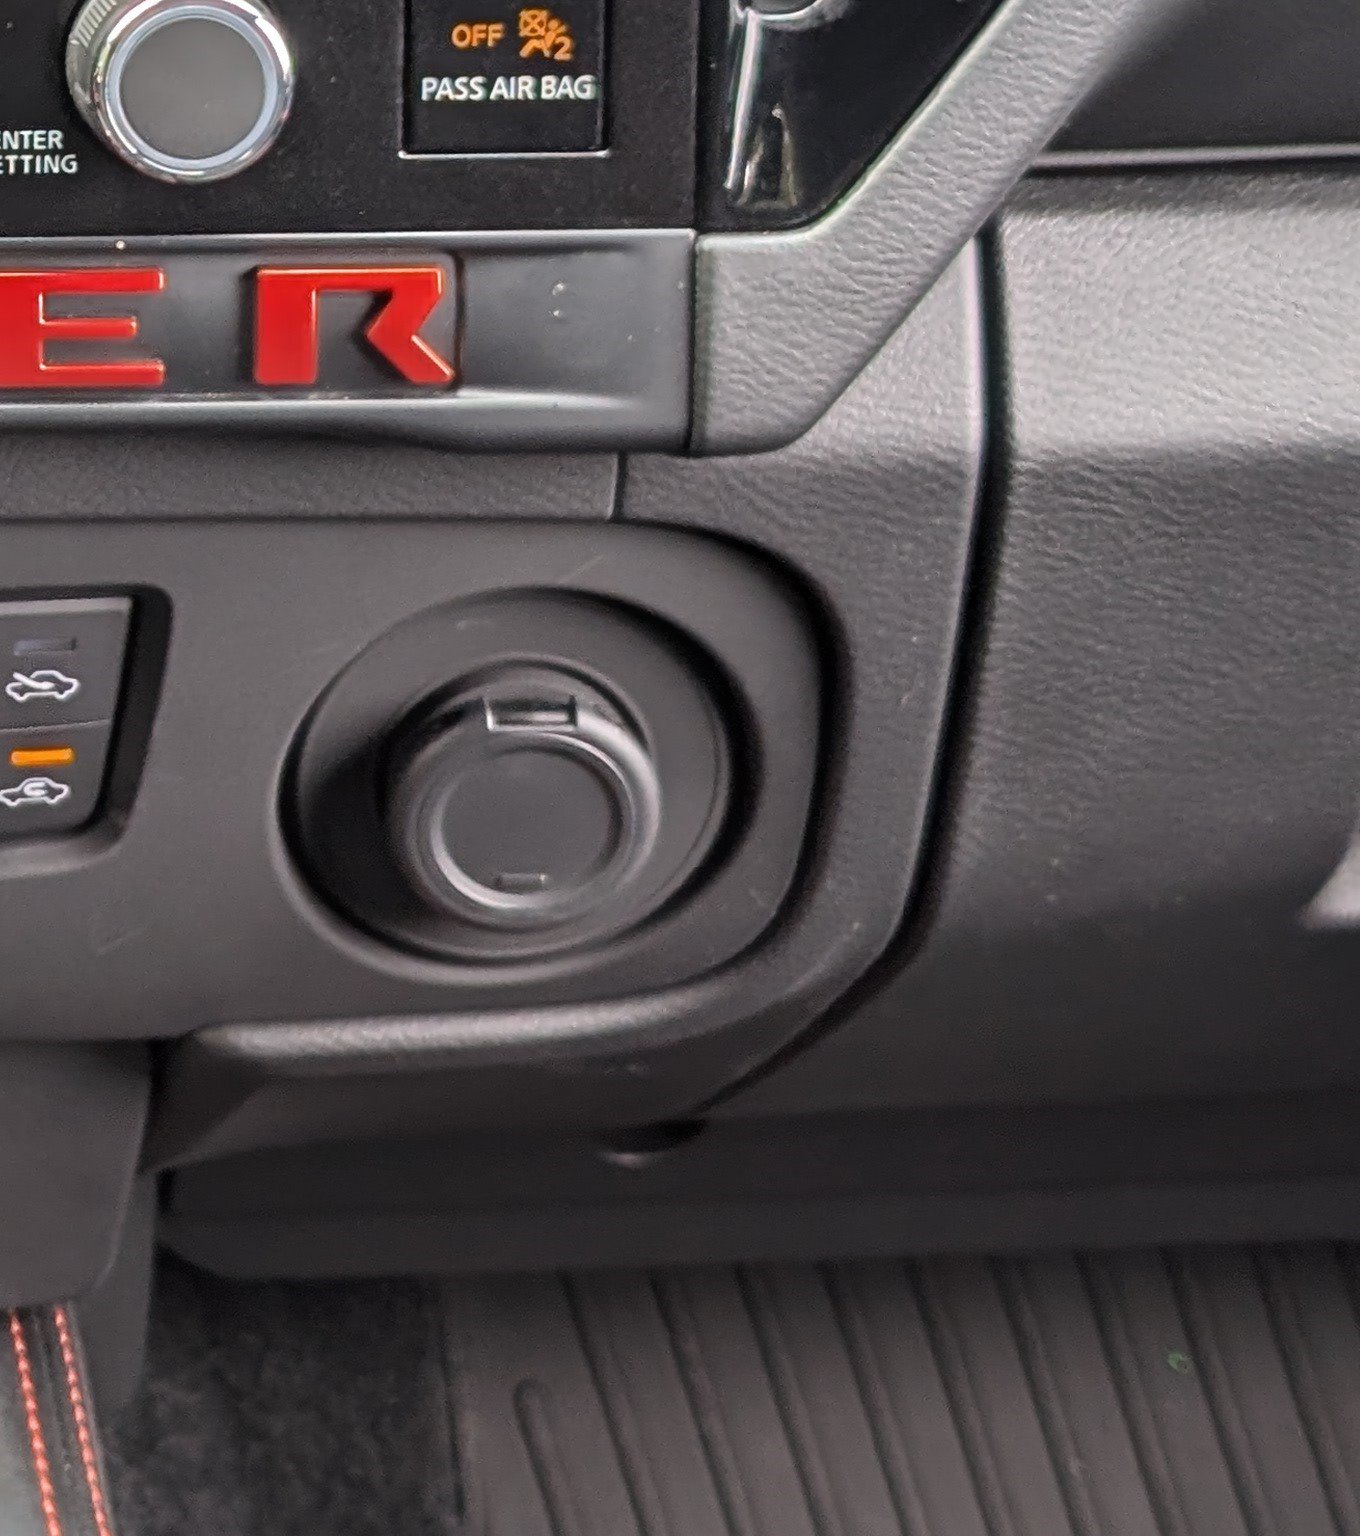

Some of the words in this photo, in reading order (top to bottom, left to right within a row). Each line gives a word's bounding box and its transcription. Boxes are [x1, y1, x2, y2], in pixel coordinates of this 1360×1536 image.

[450, 21, 507, 50] OFF
[420, 75, 488, 101] PASS
[488, 75, 538, 101] AIR
[540, 74, 598, 101] BAG
